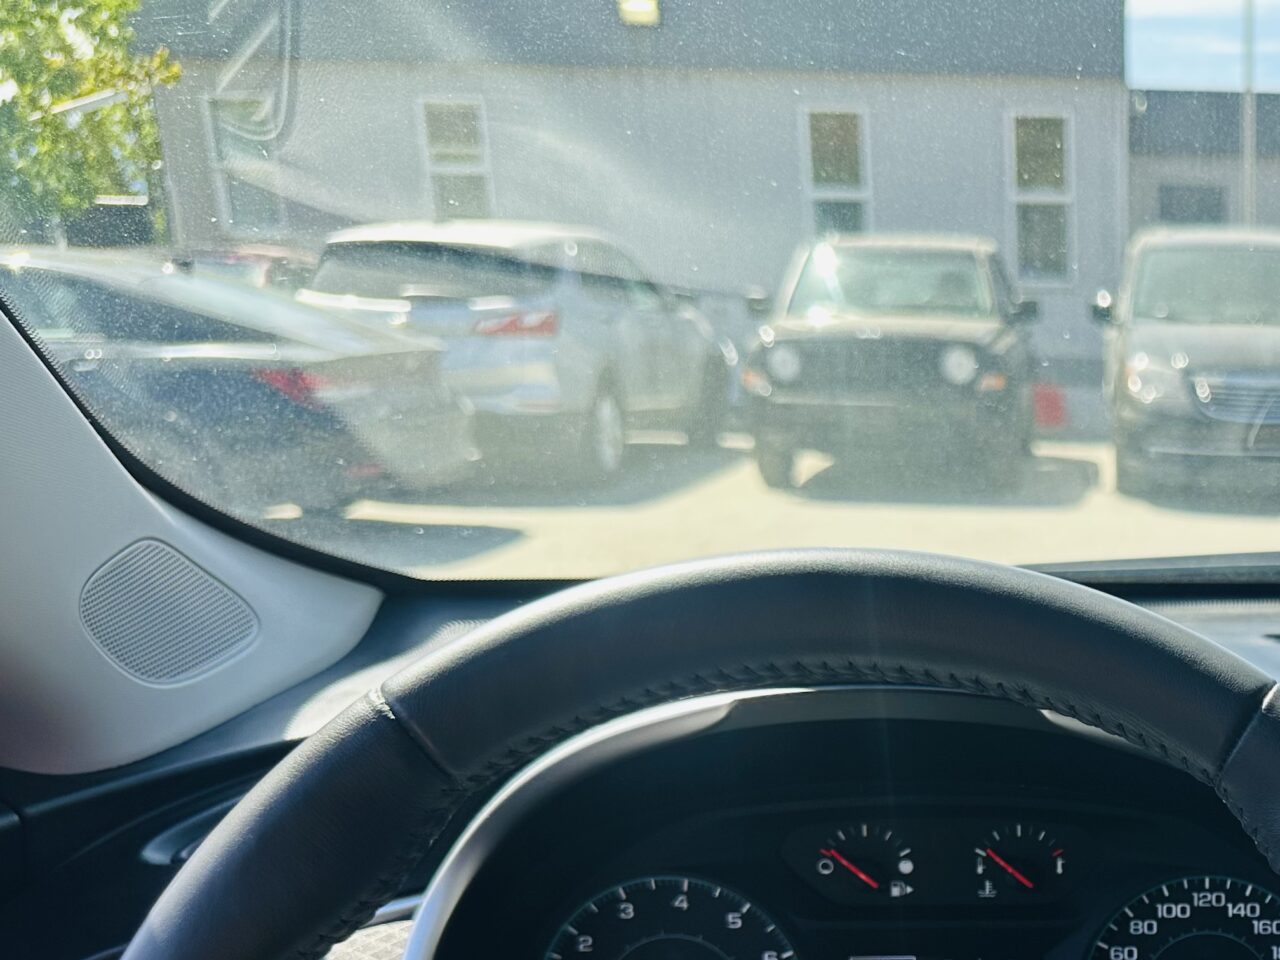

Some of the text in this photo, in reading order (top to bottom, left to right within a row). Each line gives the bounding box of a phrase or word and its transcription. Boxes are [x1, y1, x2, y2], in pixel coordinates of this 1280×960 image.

[671, 896, 688, 910] 4
[1192, 893, 1226, 906] 120
[619, 904, 634, 918] 3
[1157, 904, 1190, 918] 100
[1227, 904, 1260, 917] 140
[727, 915, 742, 928] 5
[1130, 921, 1157, 934] 80
[578, 937, 593, 951] 2
[1110, 947, 1137, 960] 60
